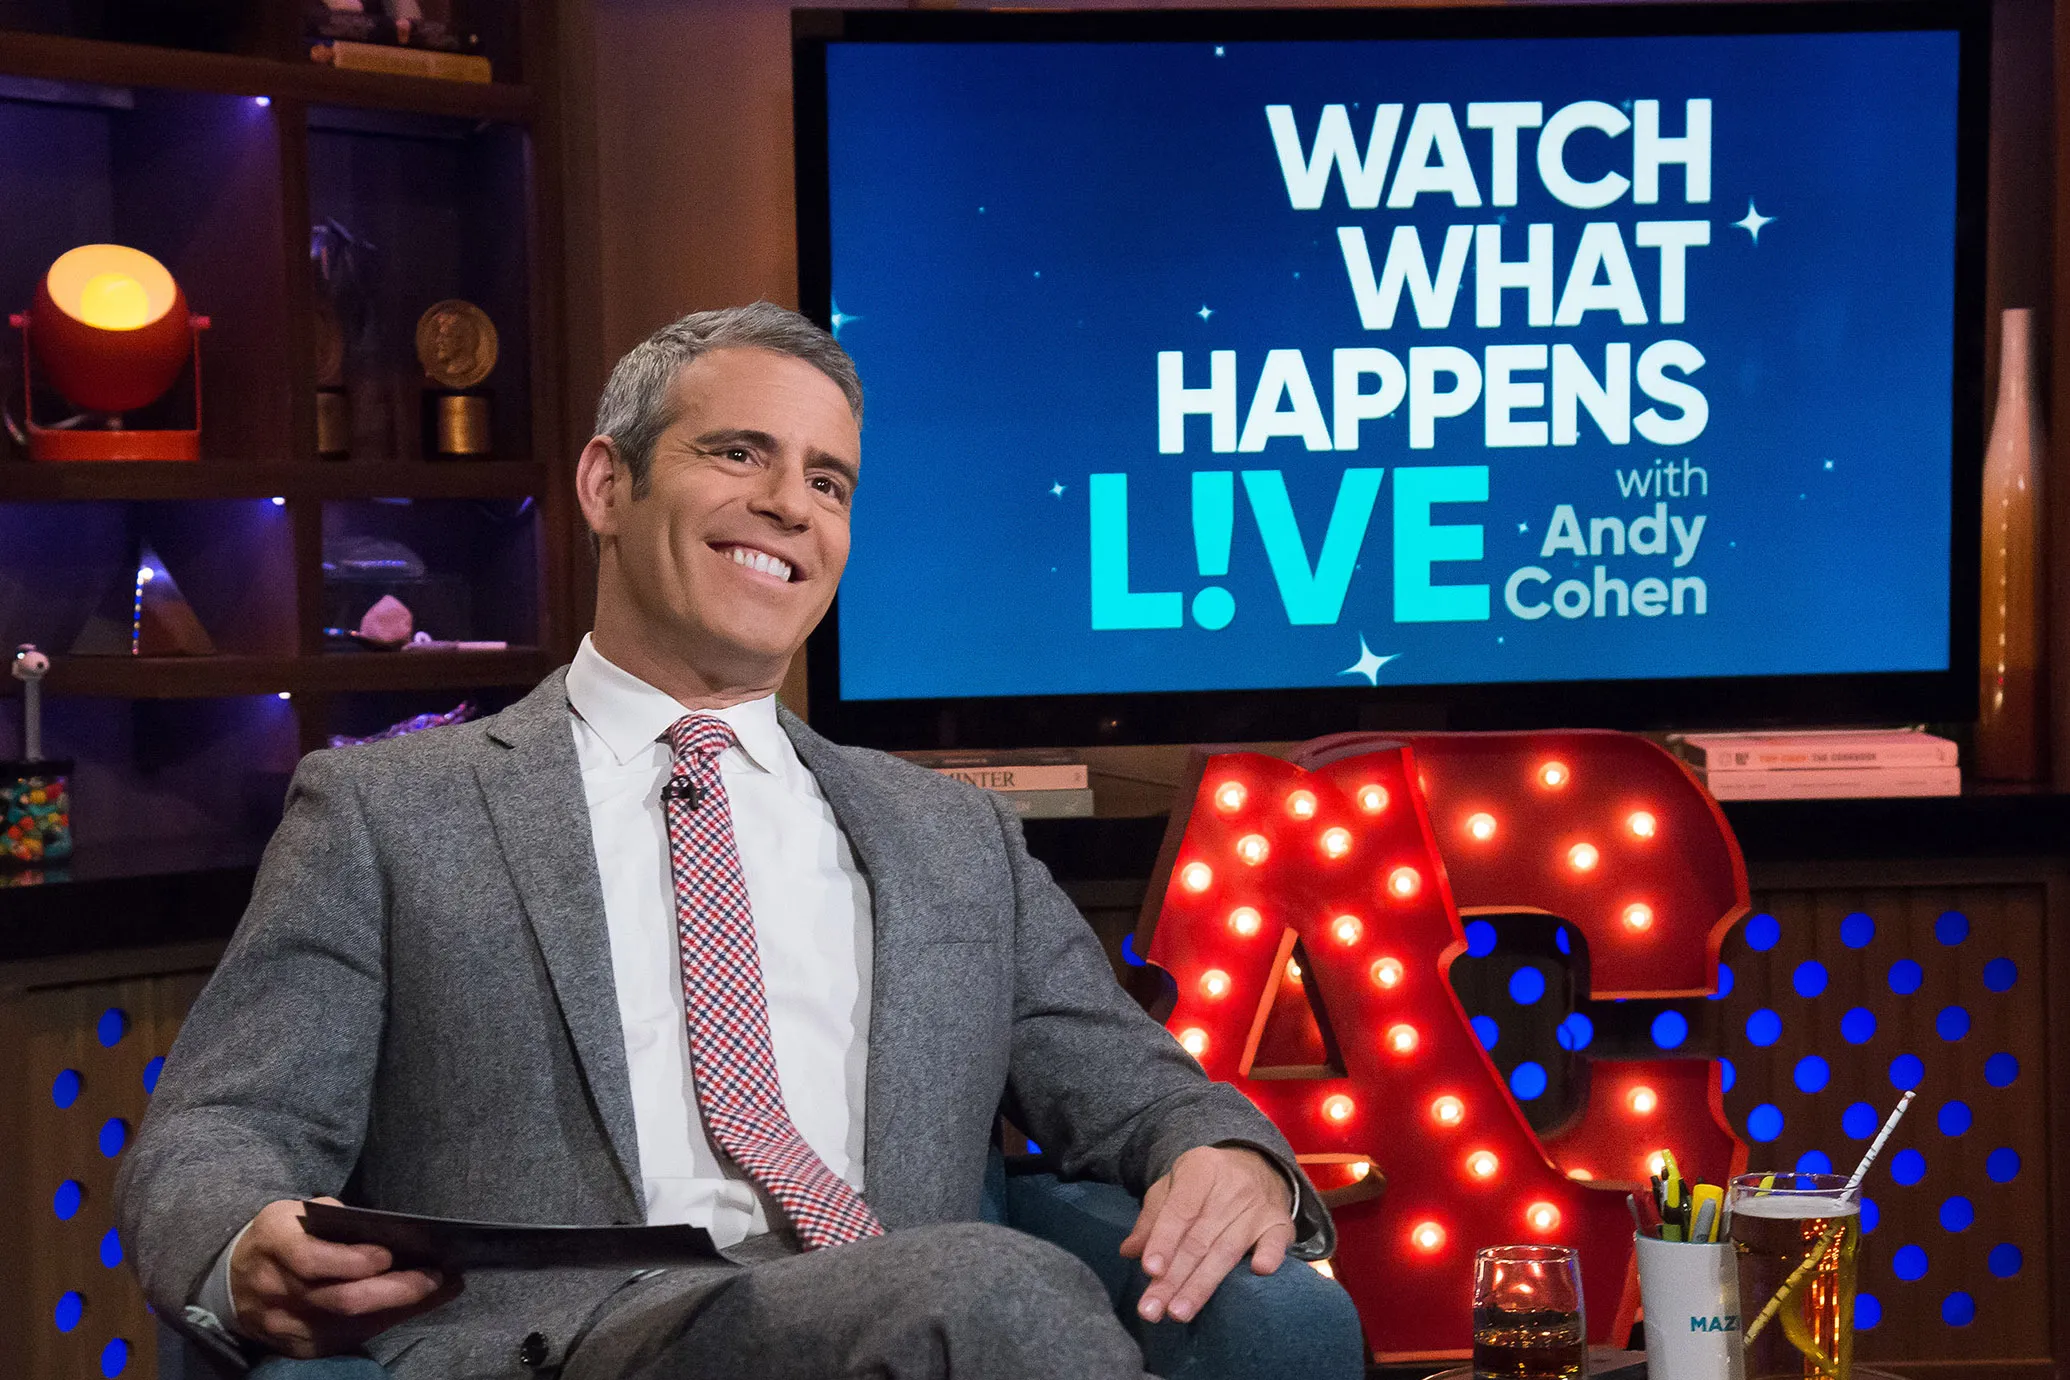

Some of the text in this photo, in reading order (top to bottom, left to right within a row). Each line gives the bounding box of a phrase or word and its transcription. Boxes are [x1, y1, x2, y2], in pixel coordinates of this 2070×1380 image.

[1265, 98, 1712, 210] WATCH
[1337, 220, 1711, 330] WHAT
[1157, 339, 1709, 455] HAPPENS
[1615, 457, 1708, 498] with
[1539, 501, 1707, 568] Andy
[1504, 564, 1708, 620] Cohen
[1690, 1315, 1741, 1332] MAZ
